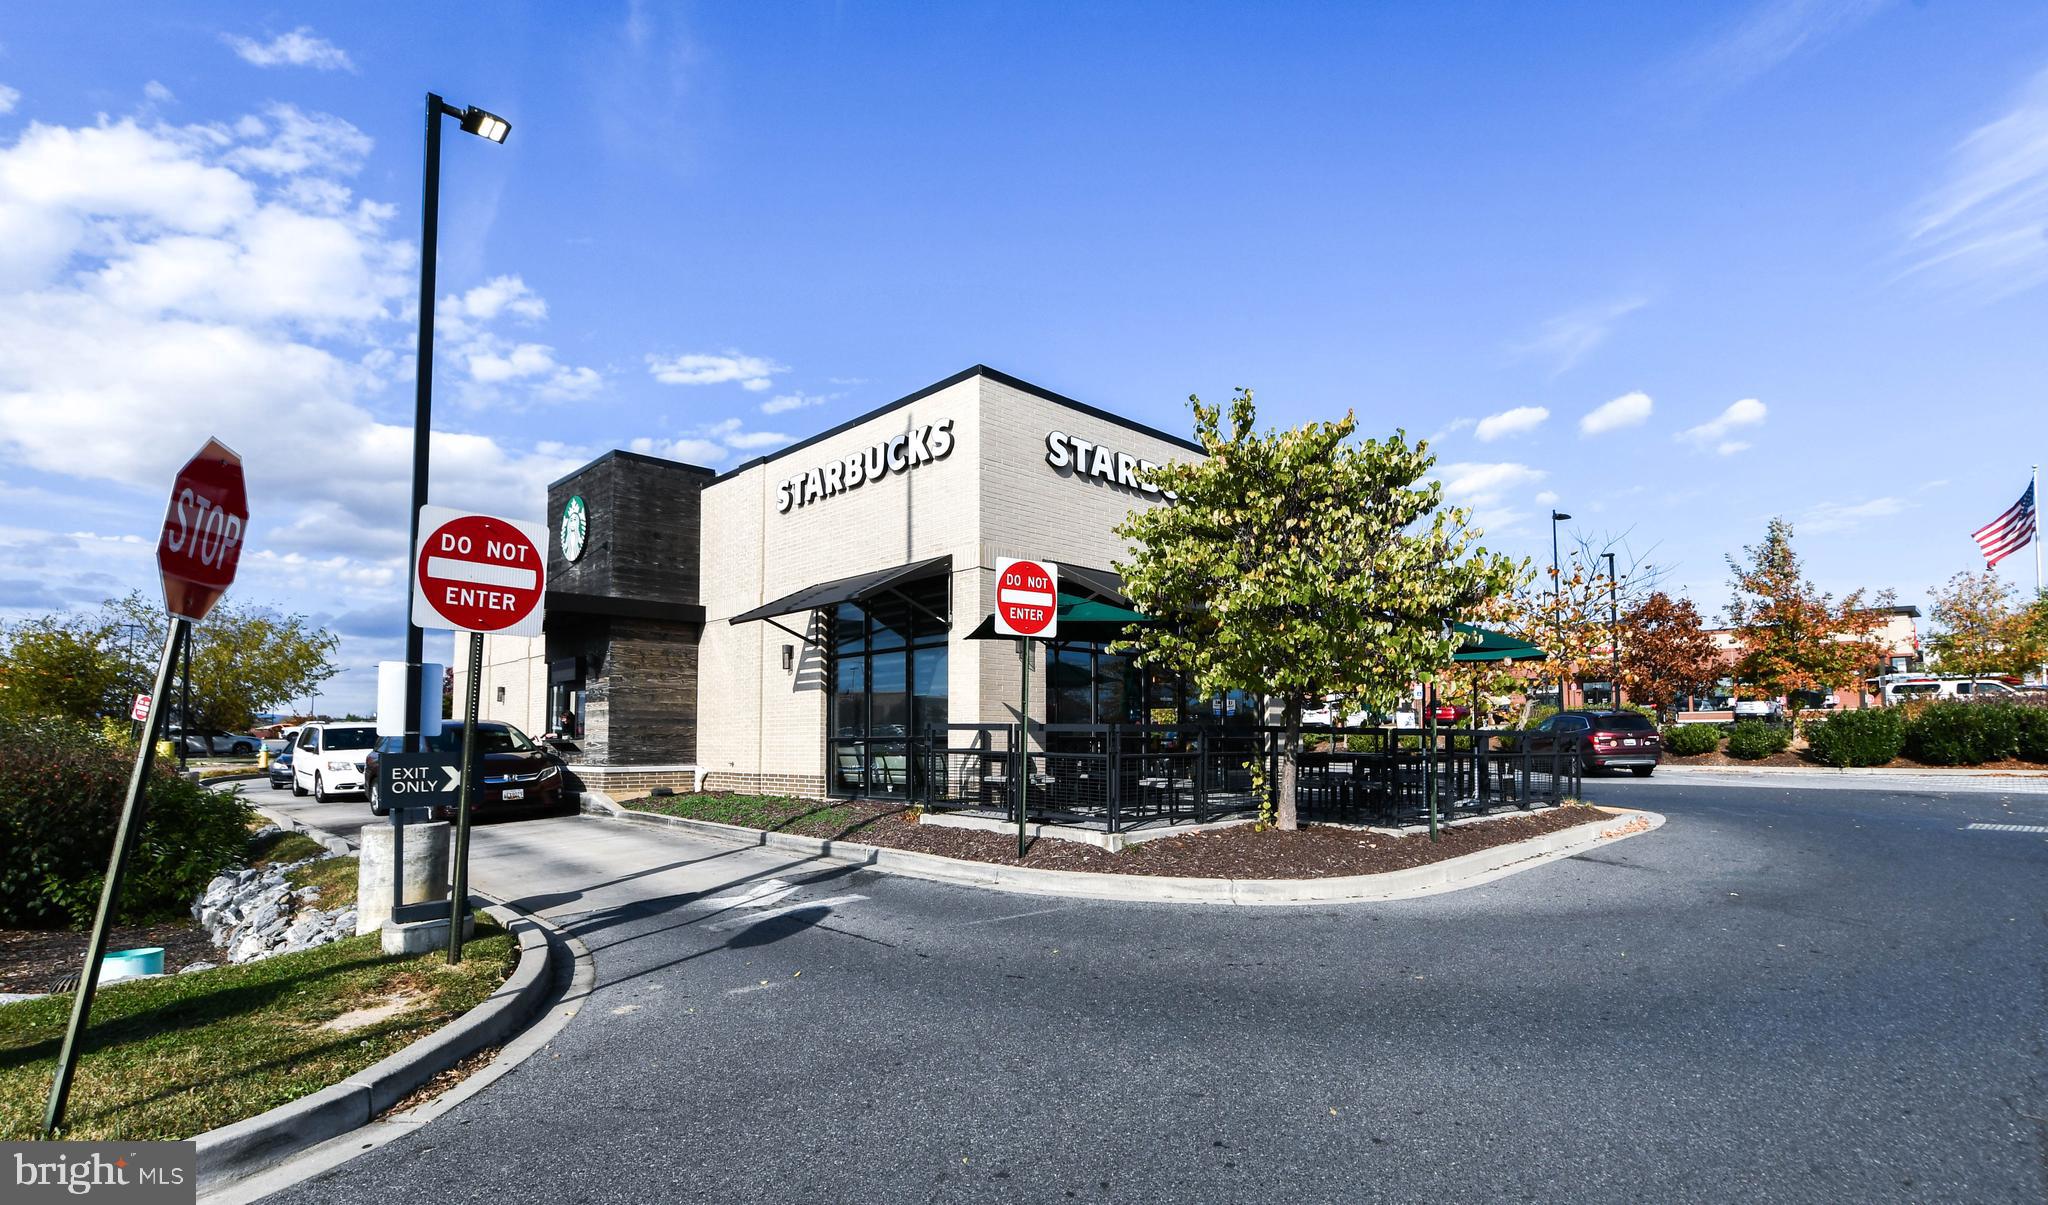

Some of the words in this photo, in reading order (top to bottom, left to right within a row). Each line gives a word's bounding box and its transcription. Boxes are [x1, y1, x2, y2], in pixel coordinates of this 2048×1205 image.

[776, 417, 955, 514] STARBUCKS
[168, 488, 241, 570] STOP
[441, 533, 472, 555] DO
[486, 540, 529, 562] NOT
[1006, 573, 1021, 586] DO
[1027, 576, 1048, 589] NOT
[445, 586, 516, 611] ENTER
[1009, 607, 1043, 621] ENTER
[392, 766, 429, 780] EXIT
[391, 780, 438, 794] ONLY
